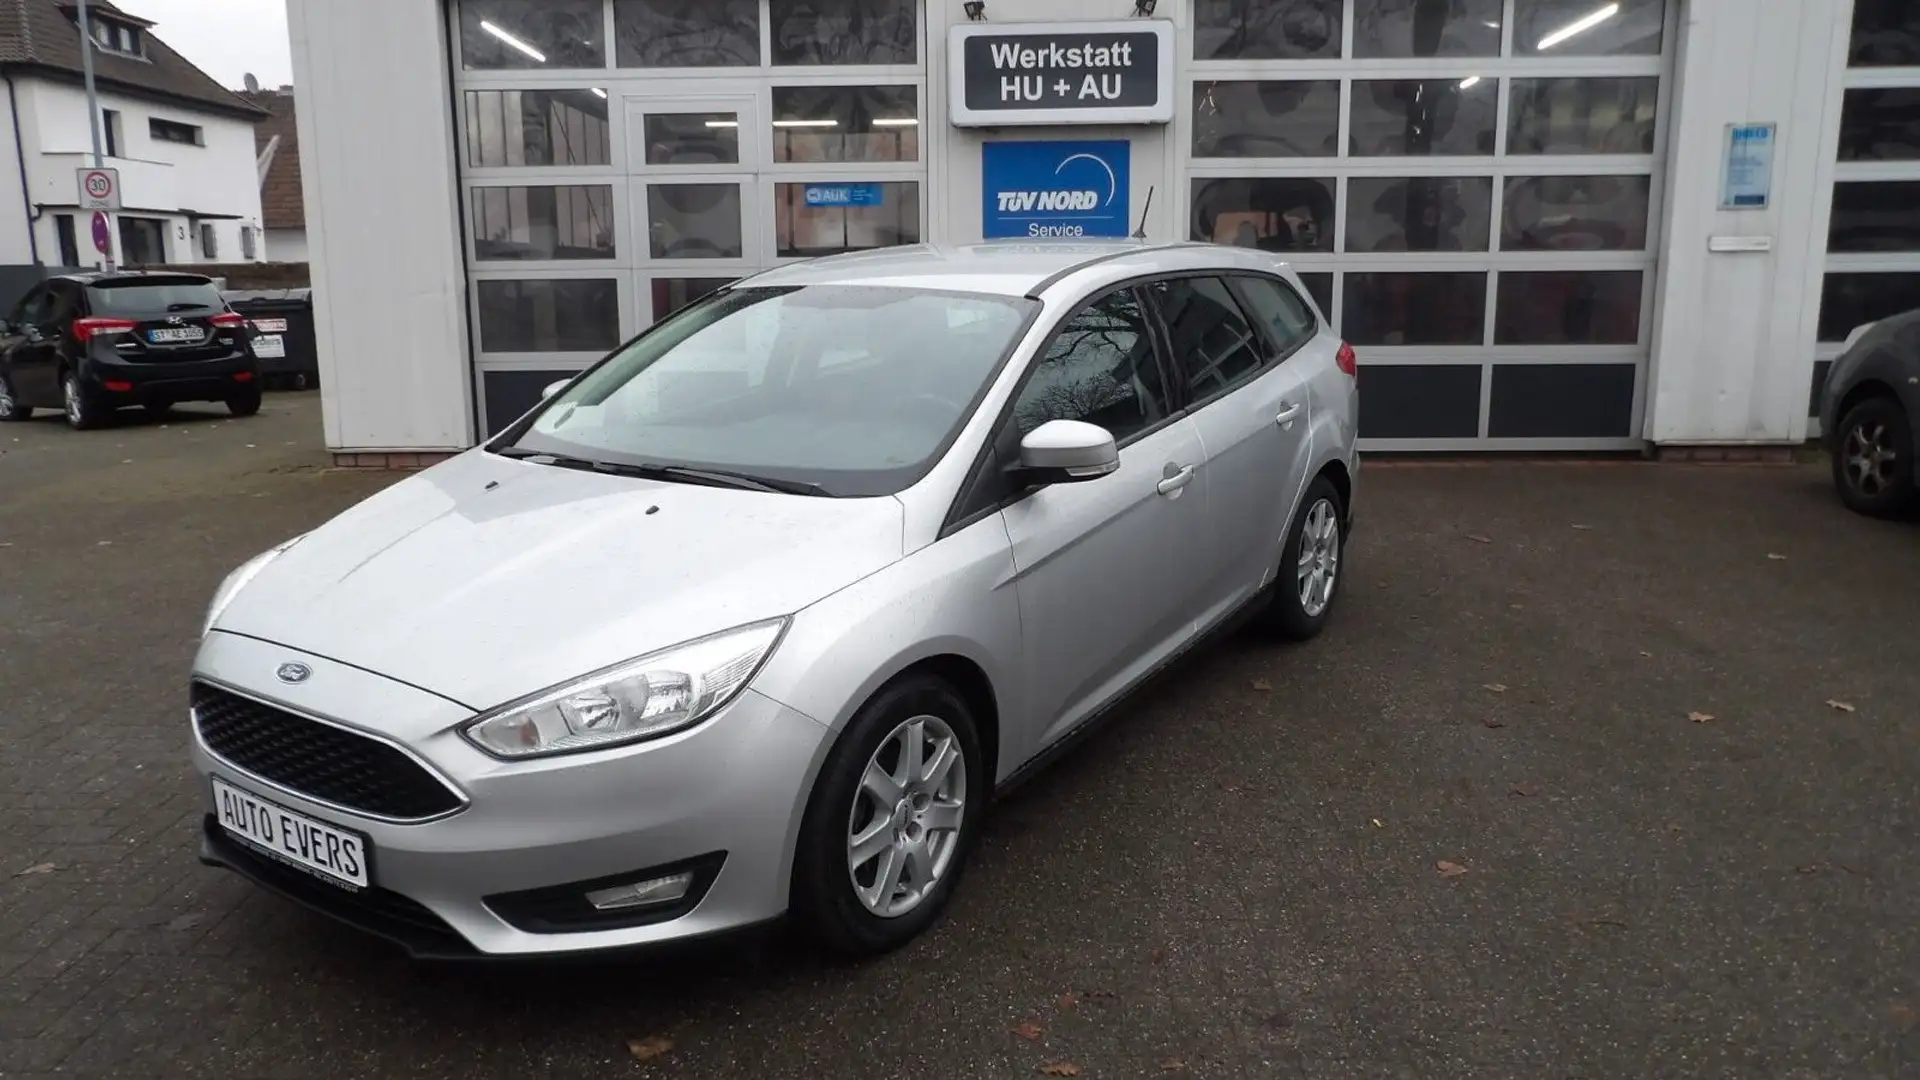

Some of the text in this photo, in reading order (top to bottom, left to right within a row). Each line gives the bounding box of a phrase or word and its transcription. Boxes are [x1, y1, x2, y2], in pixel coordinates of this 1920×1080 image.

[990, 41, 1132, 69] Werkstatt
[1001, 73, 1122, 101] HU + AU
[91, 178, 106, 191] 30
[997, 190, 1098, 212] TÜV NORD
[1028, 222, 1084, 237] Service
[280, 665, 304, 680] Ford
[222, 789, 360, 877] AUTO EVERS
